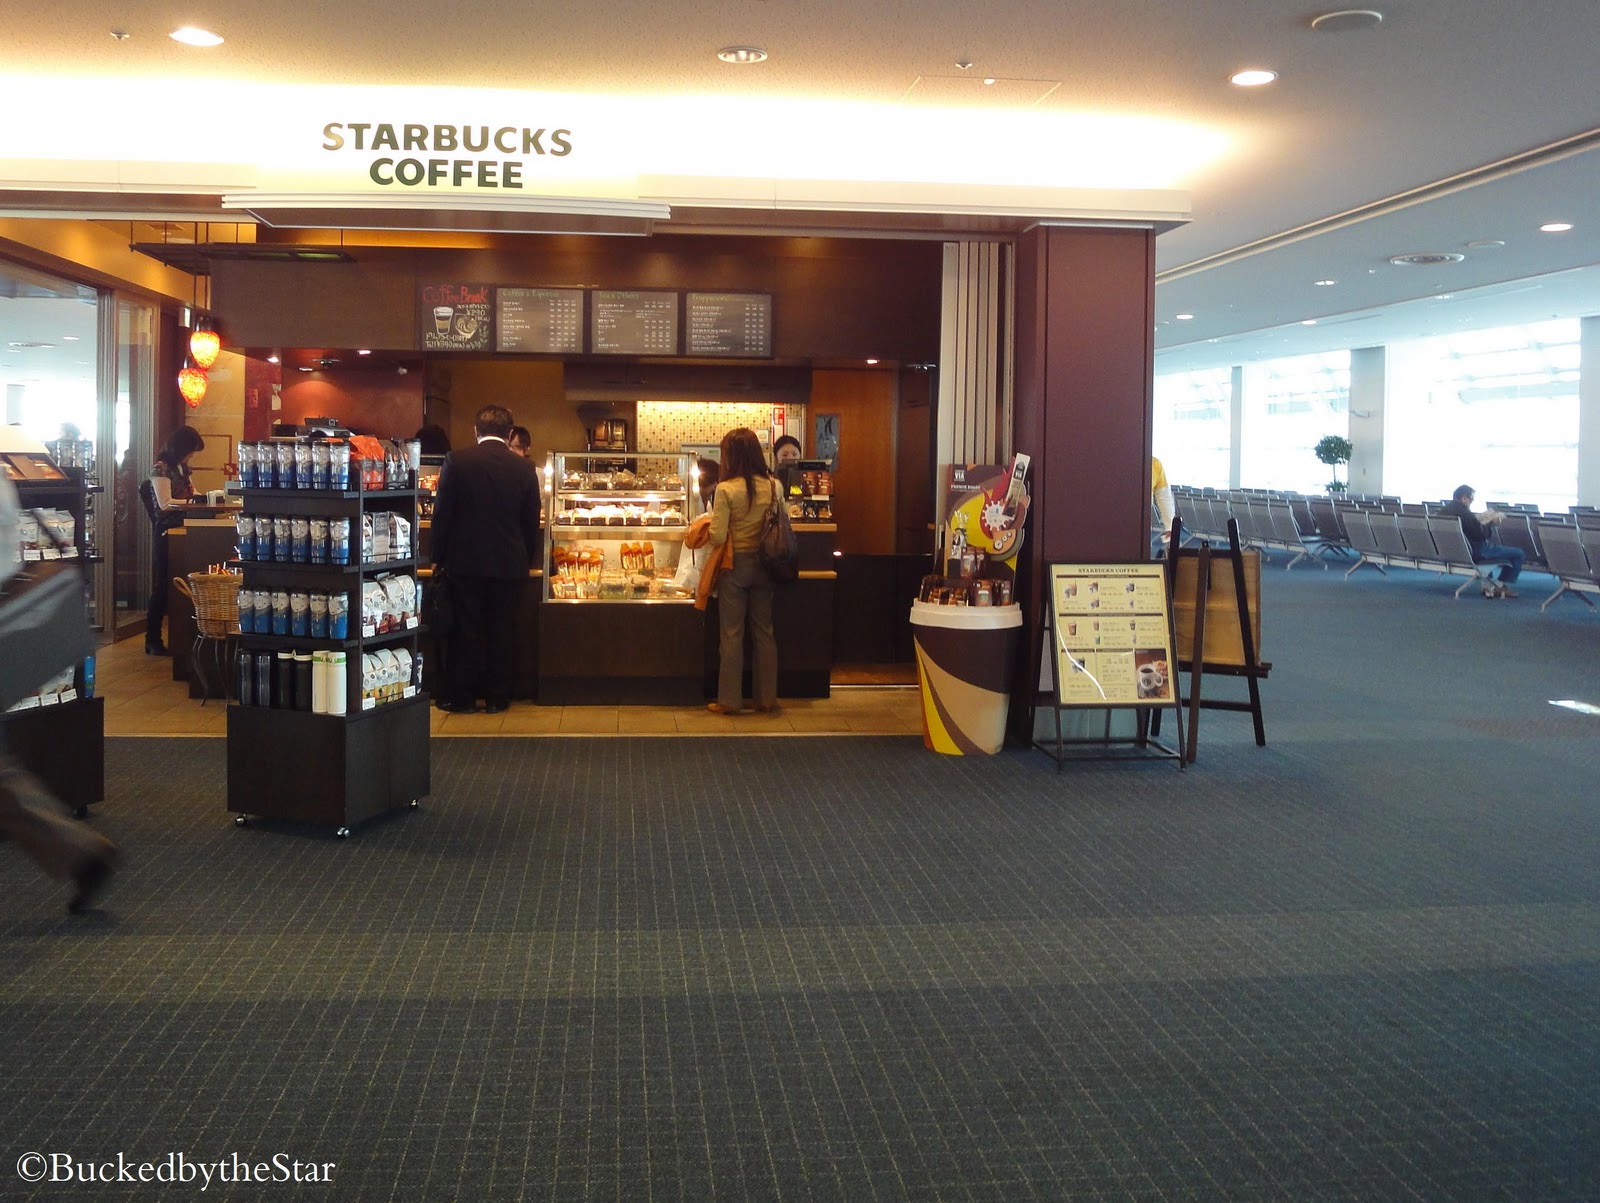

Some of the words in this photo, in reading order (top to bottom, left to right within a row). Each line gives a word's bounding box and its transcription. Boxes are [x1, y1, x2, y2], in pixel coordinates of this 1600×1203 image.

[322, 122, 573, 157] STARBUCKS
[369, 157, 523, 189] COFFEE
[954, 472, 965, 480] VIA
